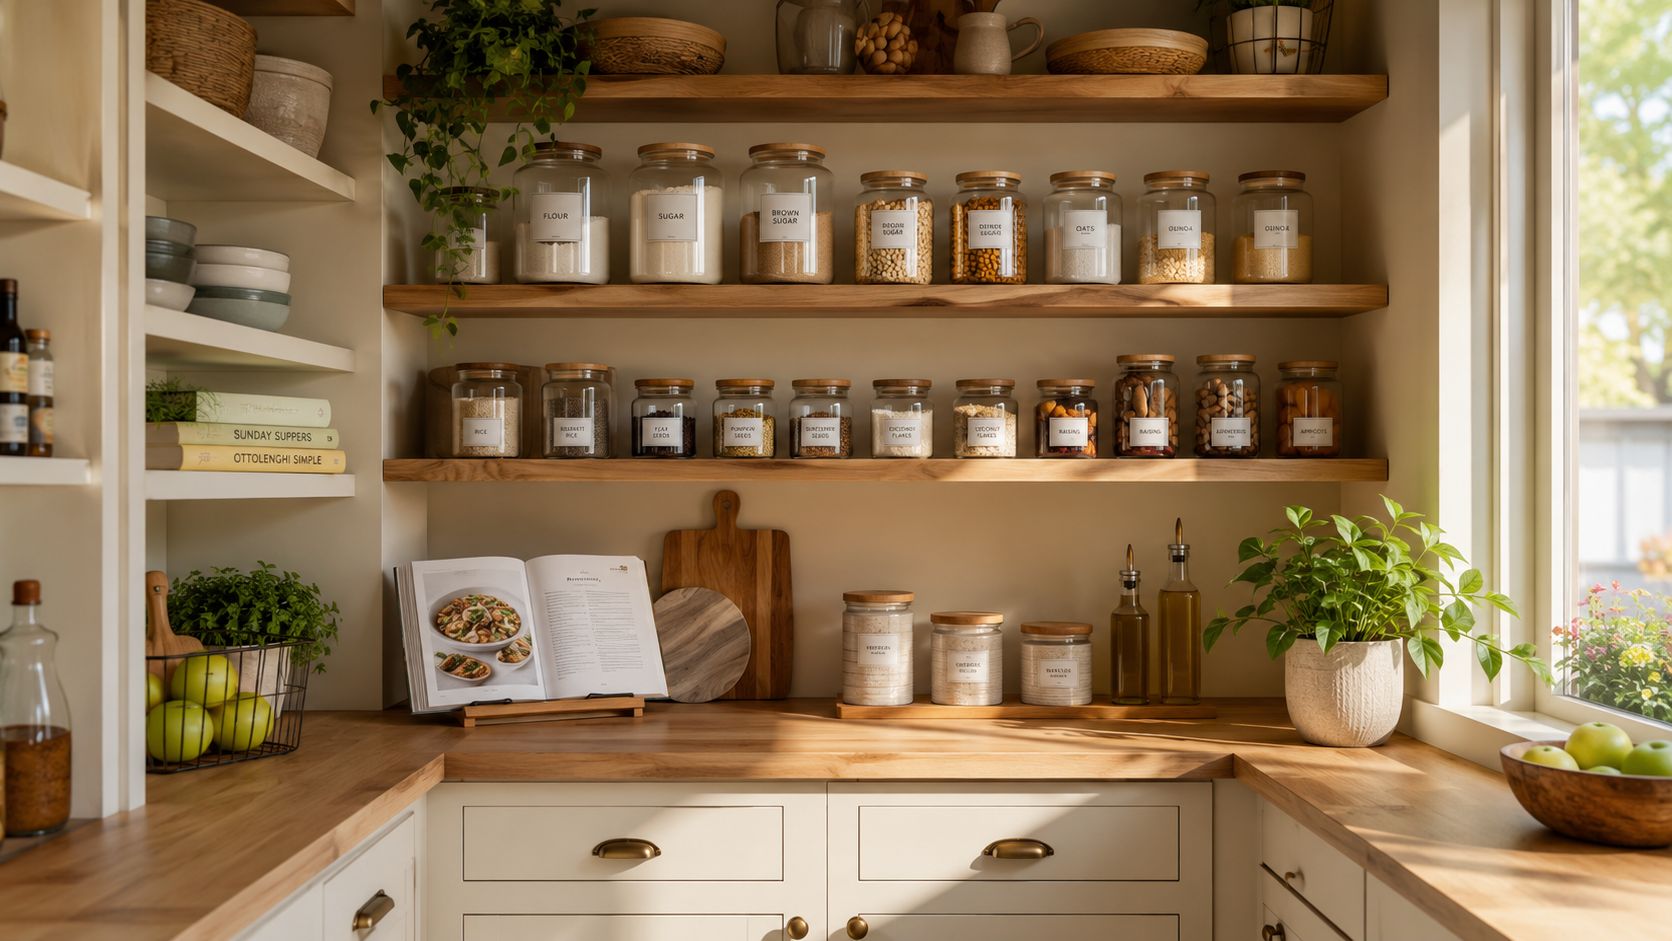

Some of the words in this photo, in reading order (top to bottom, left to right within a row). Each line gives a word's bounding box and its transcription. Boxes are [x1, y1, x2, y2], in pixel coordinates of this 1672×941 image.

[543, 212, 569, 220] FLOUR
[658, 212, 685, 220] SUGAR
[233, 429, 272, 440] SUNDAY
[274, 431, 312, 442] SUPPERS
[233, 452, 291, 464] OTTOLENGHI
[293, 454, 322, 465] SIMPLE
